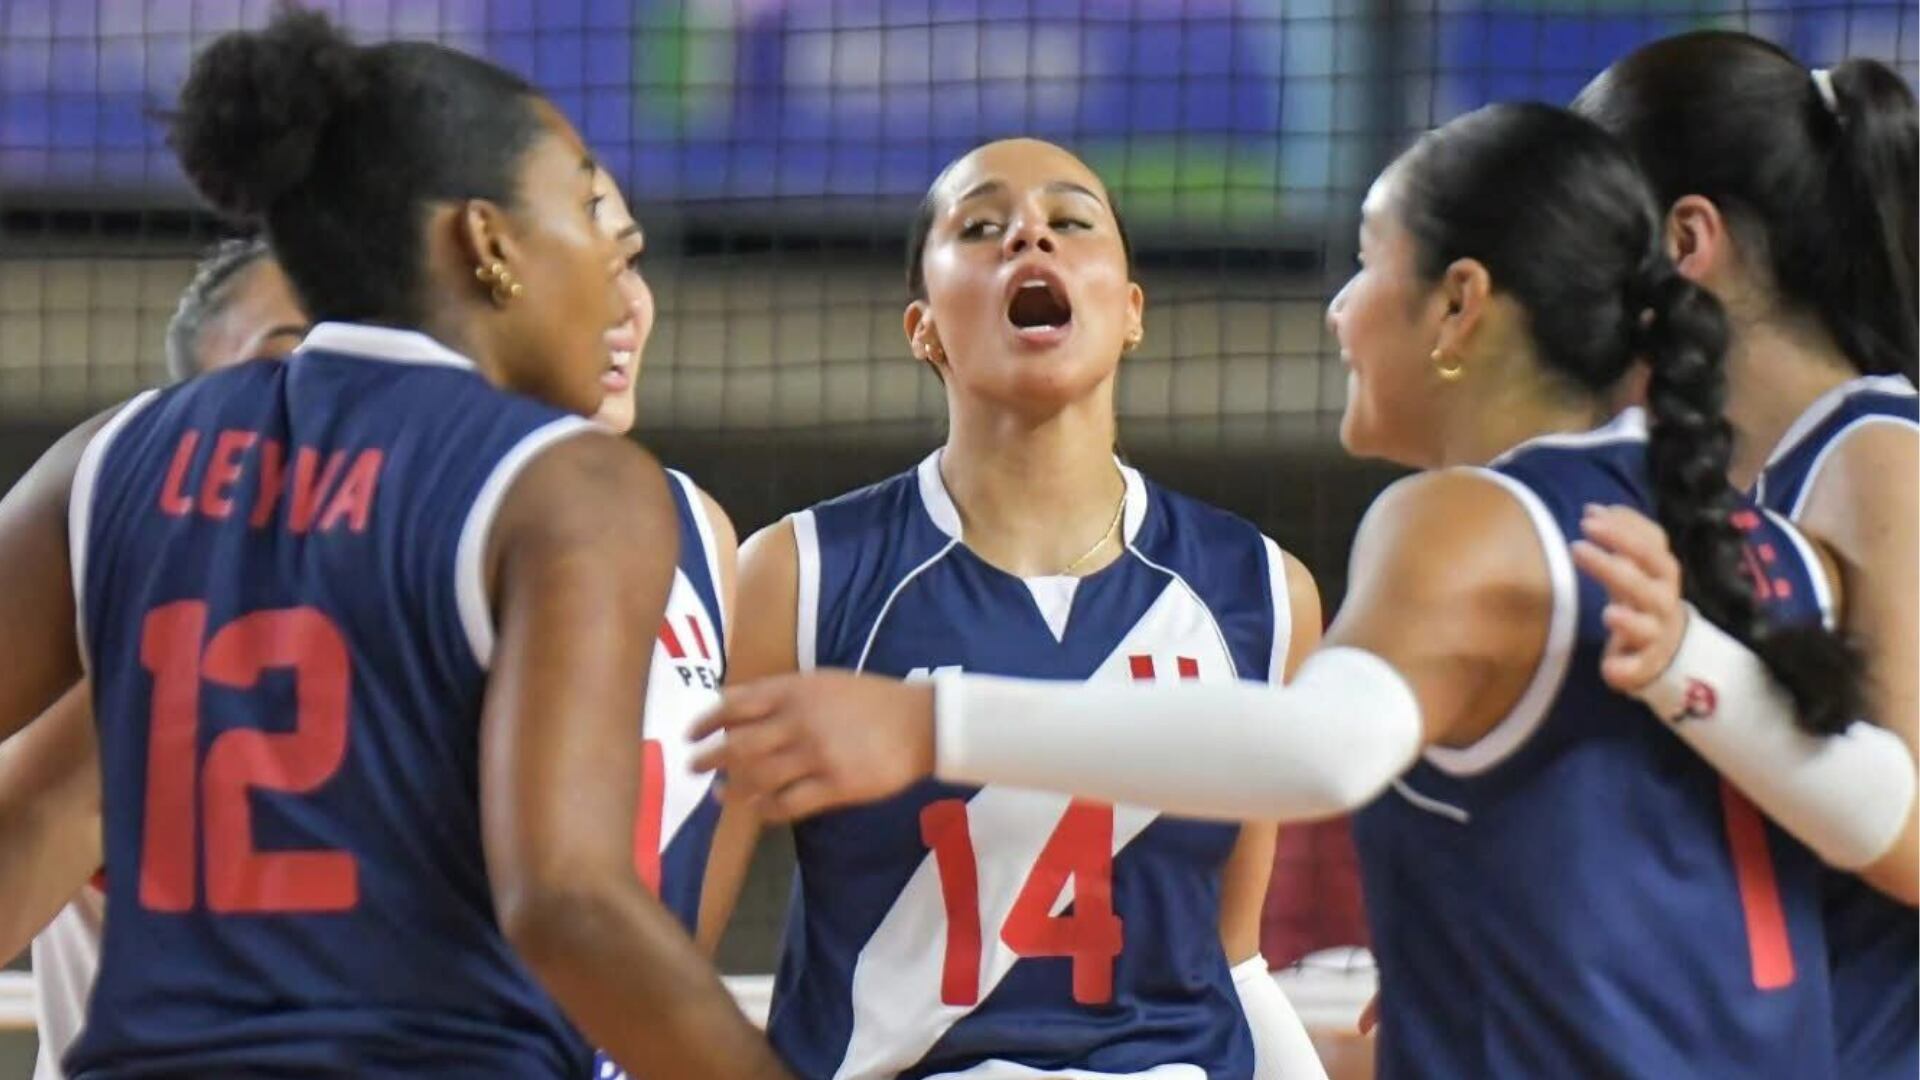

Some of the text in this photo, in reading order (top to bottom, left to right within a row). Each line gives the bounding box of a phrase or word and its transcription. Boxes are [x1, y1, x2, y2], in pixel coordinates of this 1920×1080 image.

[160, 429, 383, 533] LEYVA
[141, 601, 358, 913] 12
[920, 798, 1122, 1006] 14
